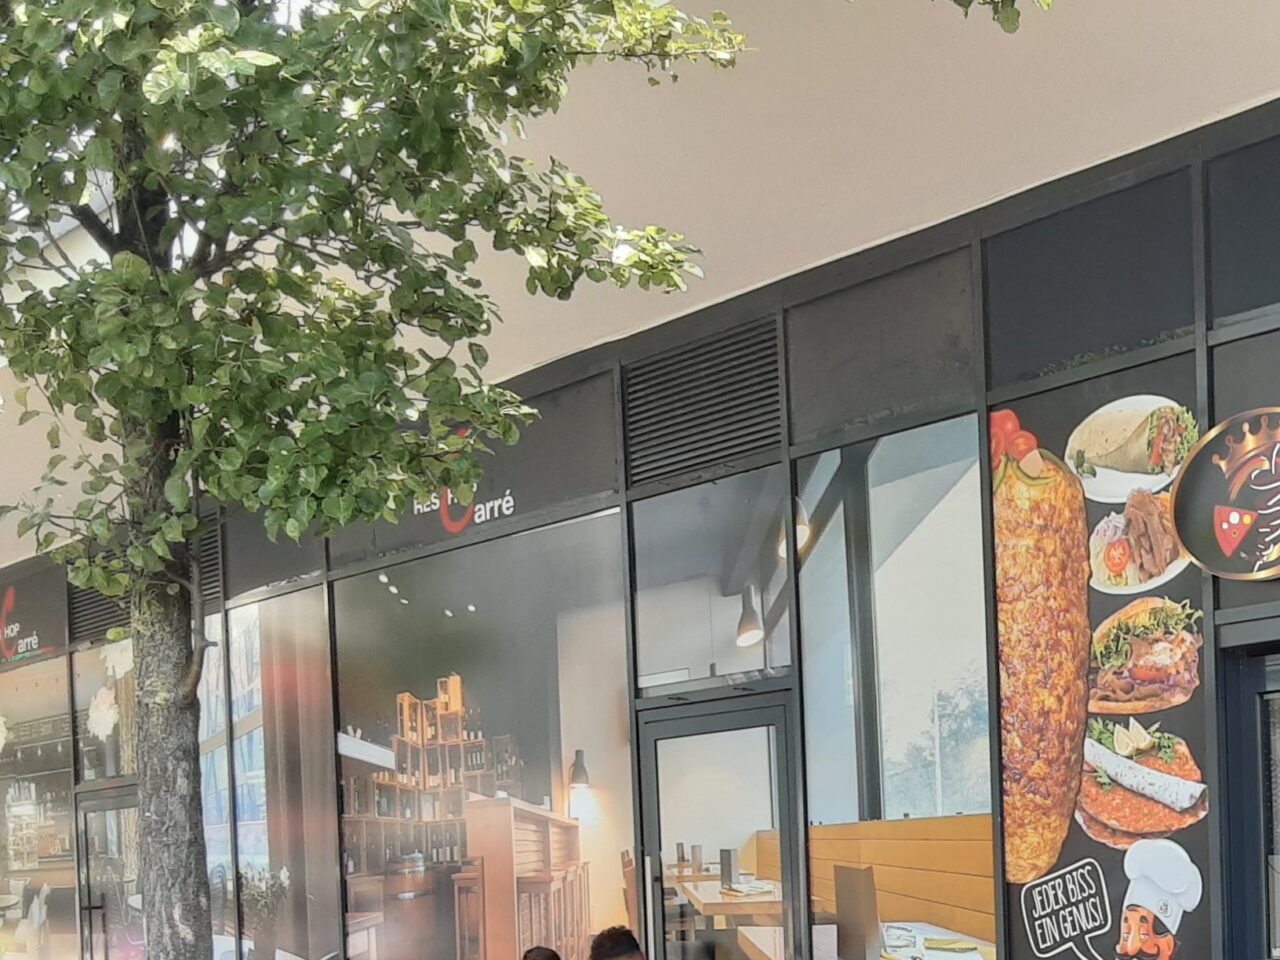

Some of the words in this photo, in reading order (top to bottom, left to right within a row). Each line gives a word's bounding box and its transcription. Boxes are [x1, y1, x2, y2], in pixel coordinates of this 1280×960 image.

[1032, 878, 1067, 918] JEDER
[1065, 866, 1096, 902] BISS
[1034, 914, 1060, 949] EIN
[1059, 896, 1104, 938] GENUS!
